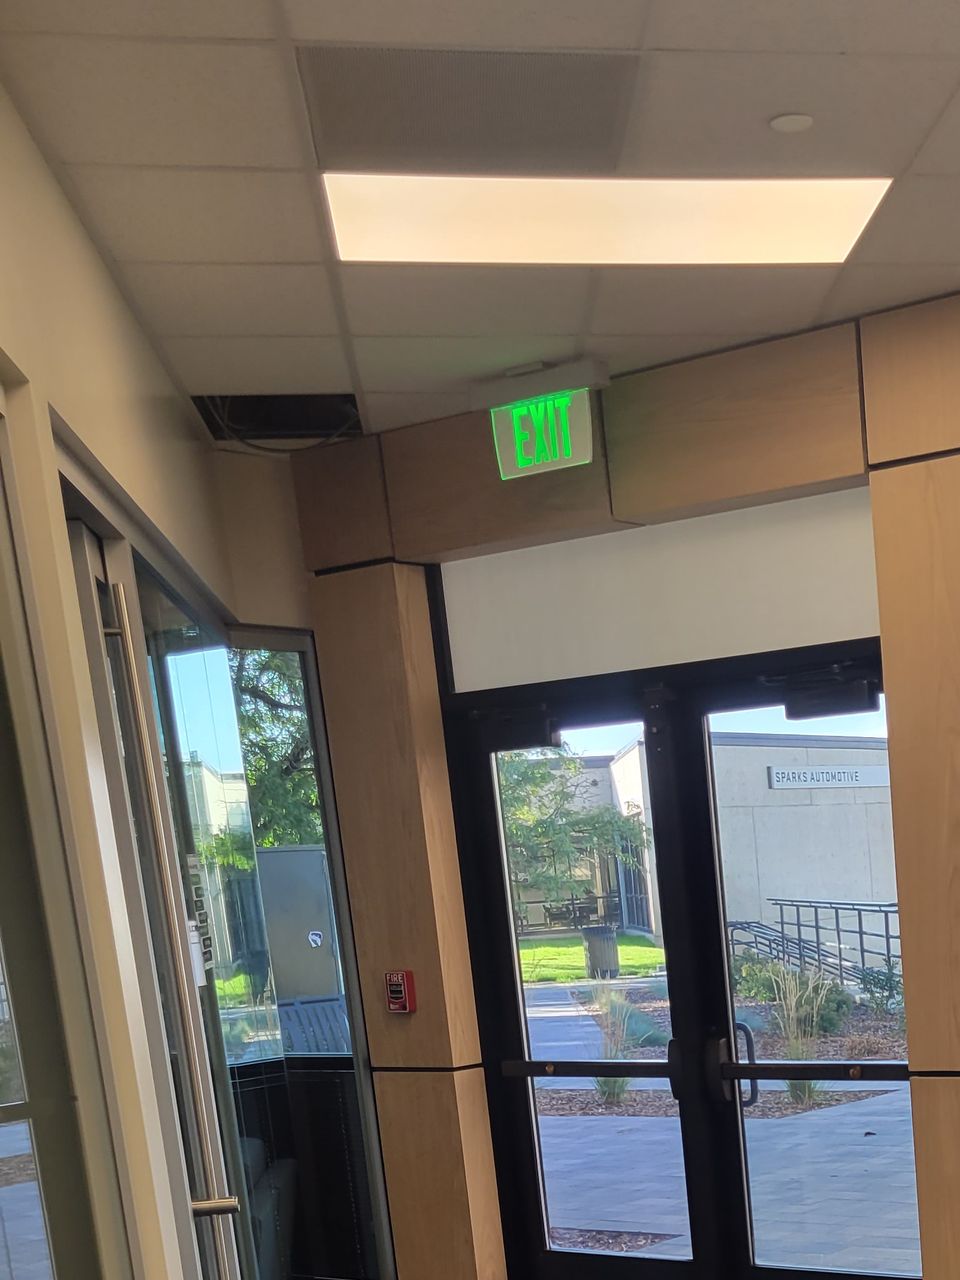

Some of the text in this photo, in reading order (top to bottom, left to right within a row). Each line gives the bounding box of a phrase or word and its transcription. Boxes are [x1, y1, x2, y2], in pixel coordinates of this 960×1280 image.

[511, 397, 573, 469] EXIT
[775, 771, 860, 783] SPARKS AUTOMOTIVE
[386, 973, 404, 983] FIRE
